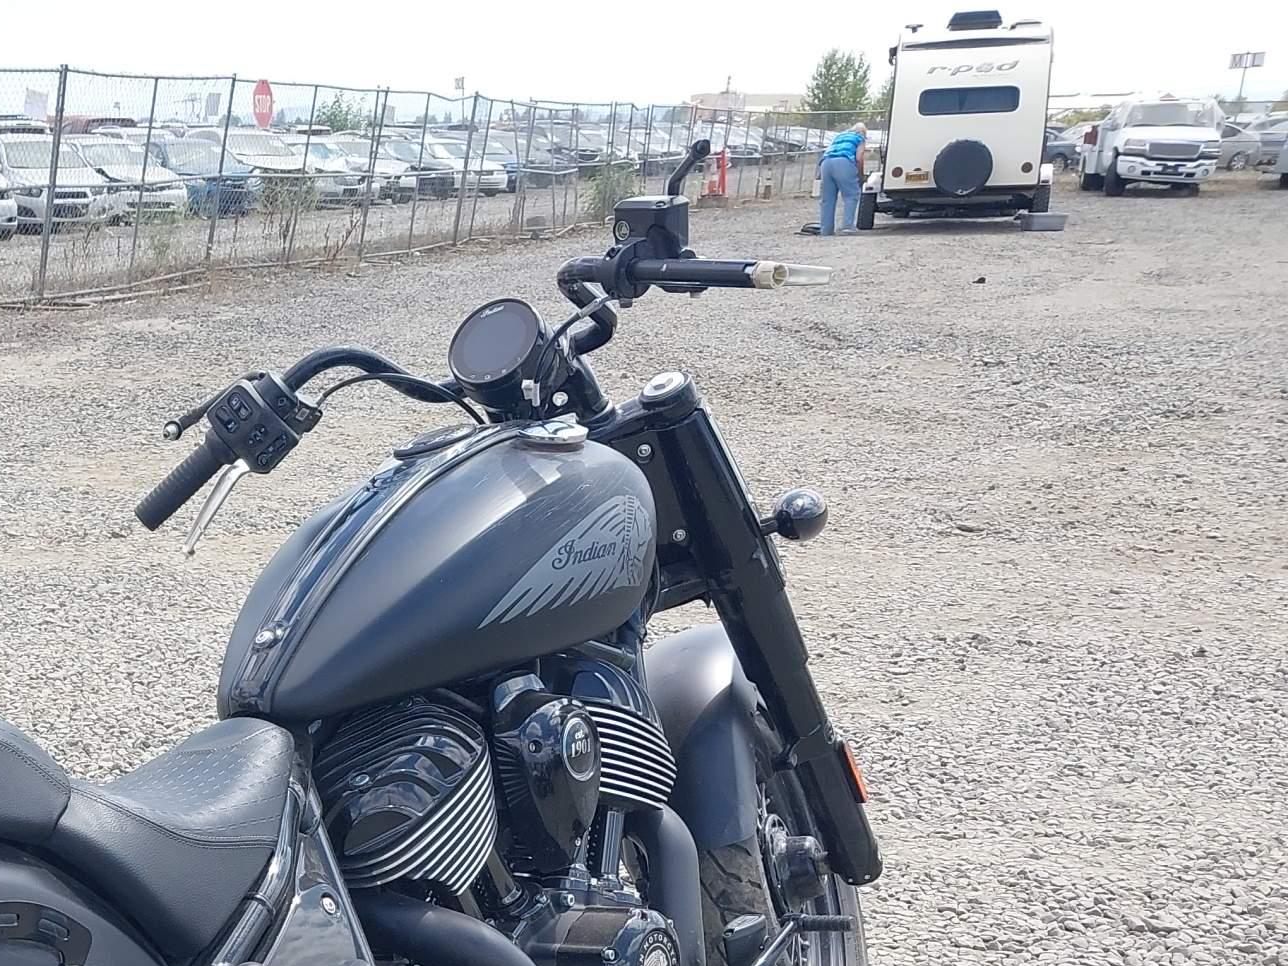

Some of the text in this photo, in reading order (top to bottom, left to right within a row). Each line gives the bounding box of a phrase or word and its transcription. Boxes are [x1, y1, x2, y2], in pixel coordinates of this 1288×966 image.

[254, 94, 272, 112] STOP
[552, 539, 617, 570] Indian
[571, 738, 591, 758] 1901
